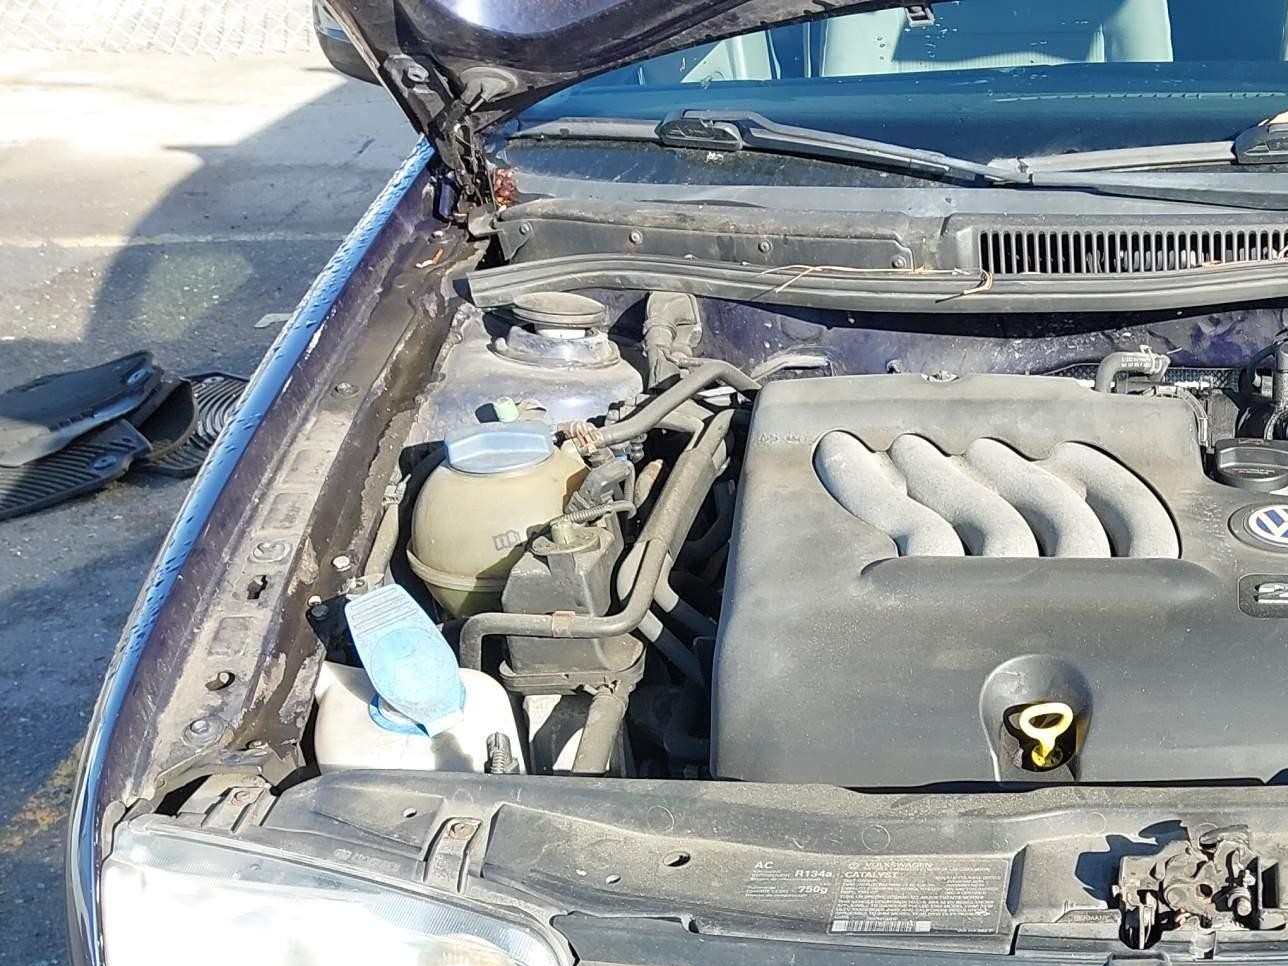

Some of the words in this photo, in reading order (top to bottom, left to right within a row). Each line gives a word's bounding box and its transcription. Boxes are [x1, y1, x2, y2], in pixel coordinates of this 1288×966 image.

[754, 861, 774, 869] AC
[794, 869, 833, 878] R134a
[845, 871, 899, 879] CATALYST
[798, 885, 829, 894] 750g
